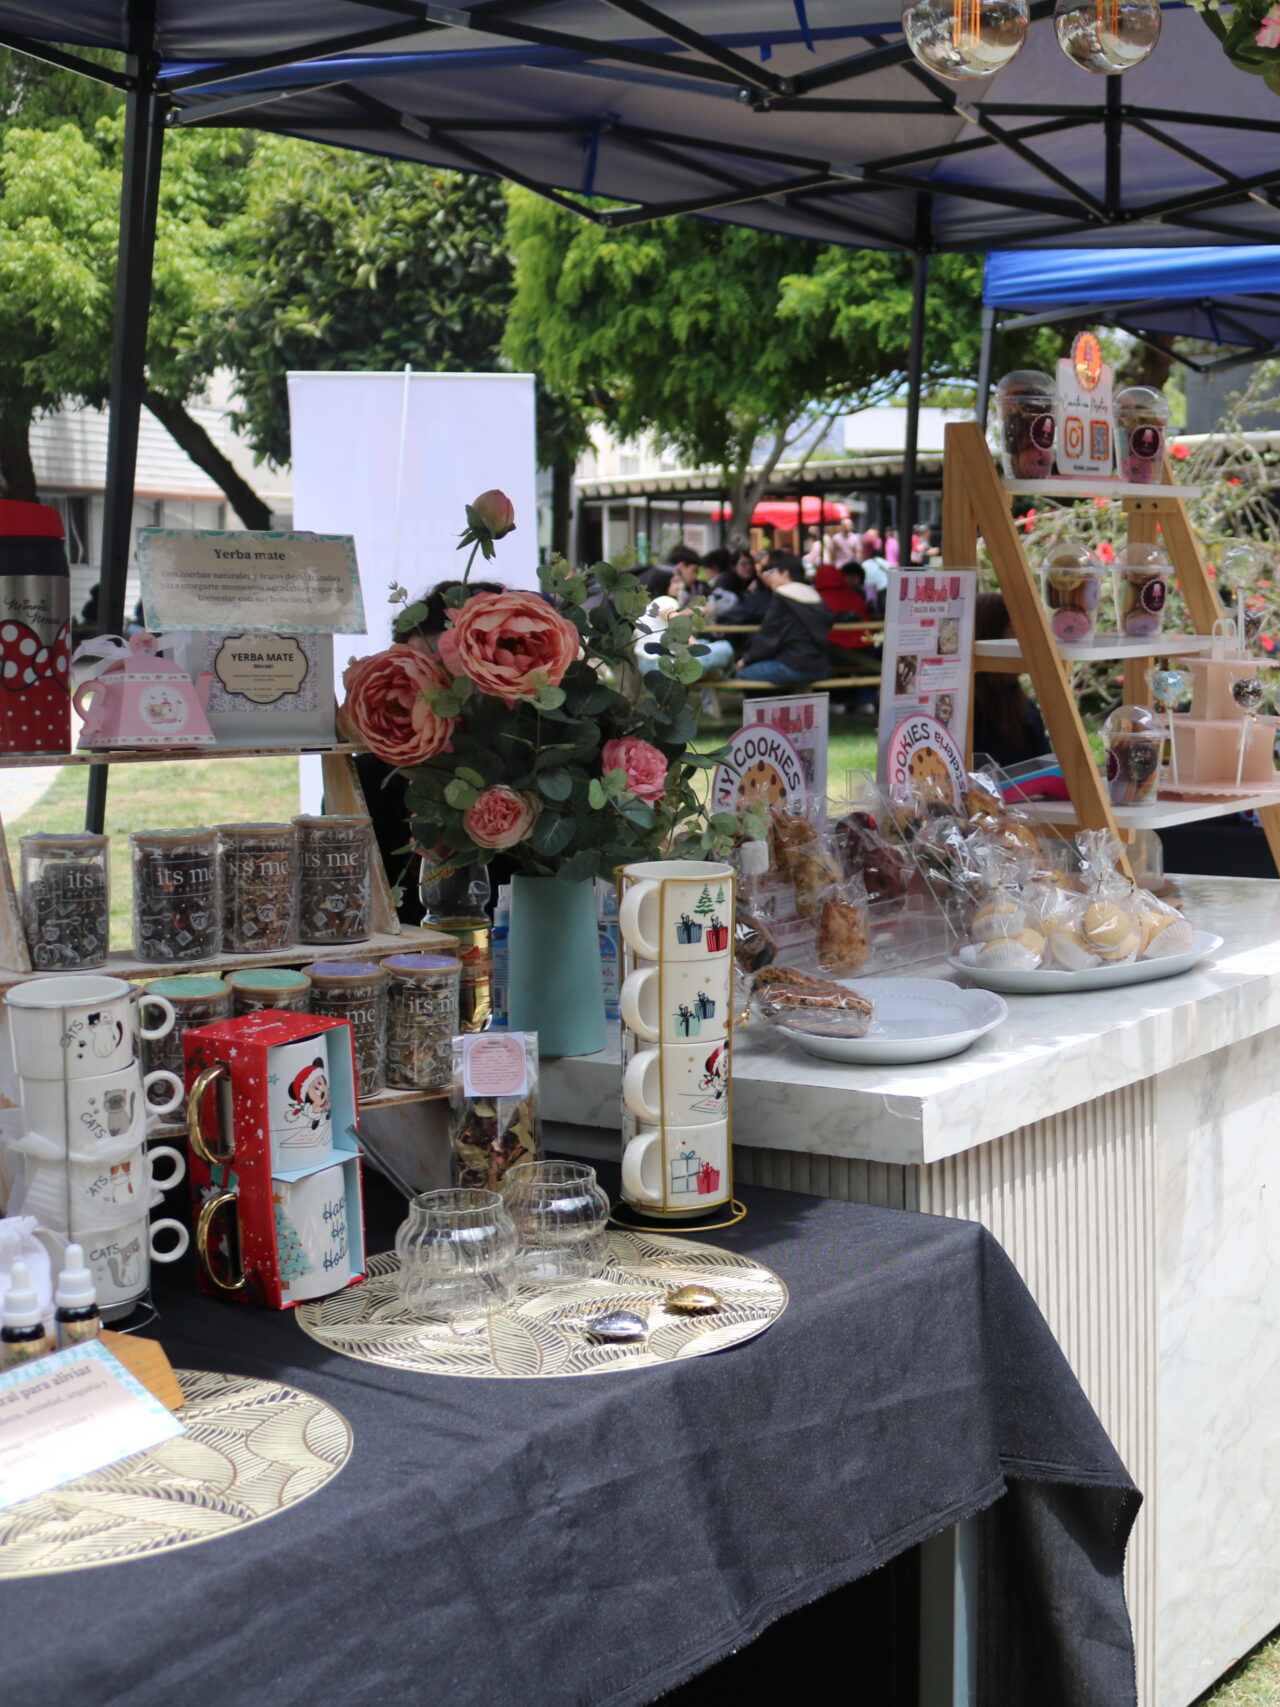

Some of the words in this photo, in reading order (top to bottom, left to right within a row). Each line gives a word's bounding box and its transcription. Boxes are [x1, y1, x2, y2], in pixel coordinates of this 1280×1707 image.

[214, 549, 251, 561] Yerba
[254, 551, 286, 561] mate
[231, 652, 265, 662] YERBA
[266, 652, 294, 662] MATE
[733, 736, 801, 791] COOKIES
[326, 851, 359, 867] me
[66, 870, 94, 889] its
[157, 867, 183, 886] its
[408, 996, 434, 1015] its
[60, 1020, 84, 1049] CATS
[80, 1112, 107, 1139] CATS
[85, 1175, 109, 1198] ATS
[89, 1243, 121, 1262] CATS
[20, 1381, 51, 1400] para
[51, 1365, 92, 1386] aliviar
